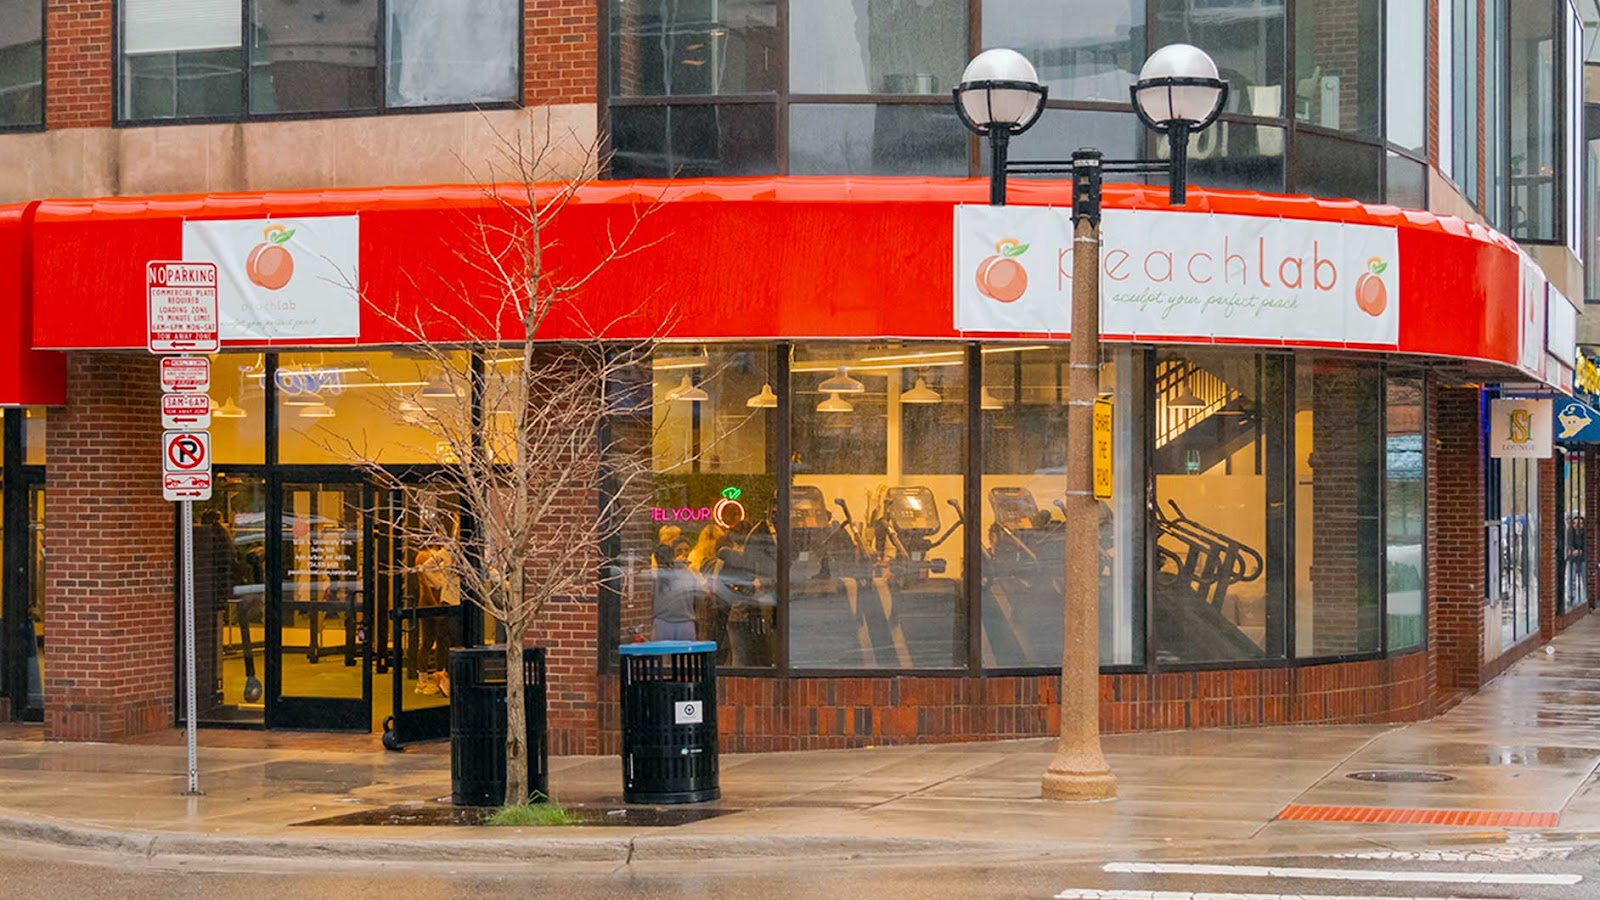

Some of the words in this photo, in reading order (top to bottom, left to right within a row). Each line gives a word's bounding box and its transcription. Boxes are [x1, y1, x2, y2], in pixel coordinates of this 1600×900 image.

[1058, 235, 1338, 291] peachlab
[149, 266, 166, 284] NO
[168, 269, 214, 283] PARKING
[1112, 287, 1163, 312] sculpt
[1162, 294, 1200, 320] your
[1200, 291, 1256, 318] perfect
[1255, 295, 1299, 317] peach
[157, 314, 164, 322] 15
[157, 332, 171, 340] TOW
[174, 332, 192, 340] AWAY
[195, 332, 212, 340] ZONE
[671, 506, 710, 521] YOUR
